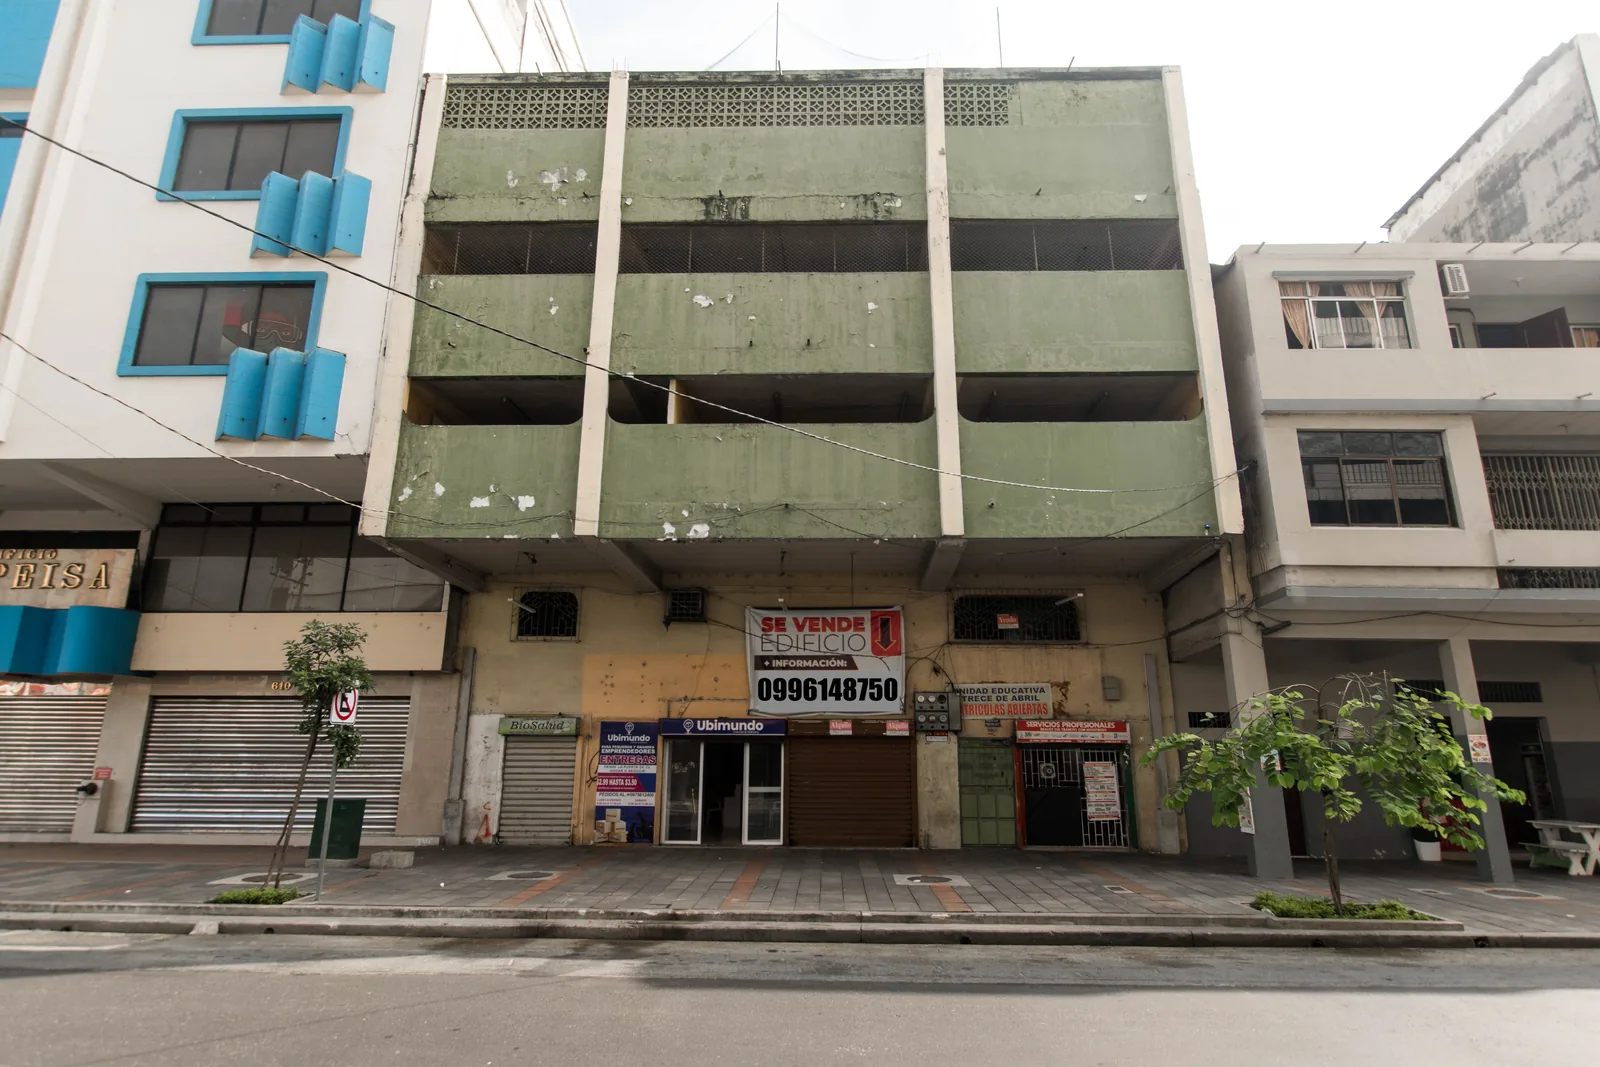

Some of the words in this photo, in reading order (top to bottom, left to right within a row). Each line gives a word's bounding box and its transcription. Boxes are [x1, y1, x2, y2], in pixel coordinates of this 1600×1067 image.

[761, 617, 787, 633] SE
[792, 617, 866, 633] VENDE
[761, 634, 867, 652] EDIFICIO
[772, 659, 848, 668] INFORMACIÓN:
[271, 682, 291, 691] 610
[757, 677, 898, 702] 0996148750
[957, 687, 989, 695] NIDAD
[991, 687, 1046, 695] EDUCATIVA
[1011, 694, 1040, 702] ABRIL
[961, 703, 1006, 716] TRICULAS
[1007, 703, 1049, 716] ABIERTAS
[510, 721, 565, 731] BioSalud
[697, 719, 764, 731] Ubimundo
[1062, 721, 1116, 729] PROFESIONALES
[608, 734, 650, 742] Ubimundo
[600, 755, 656, 764] ENTREGAS
[609, 778, 625, 786] HASTA
